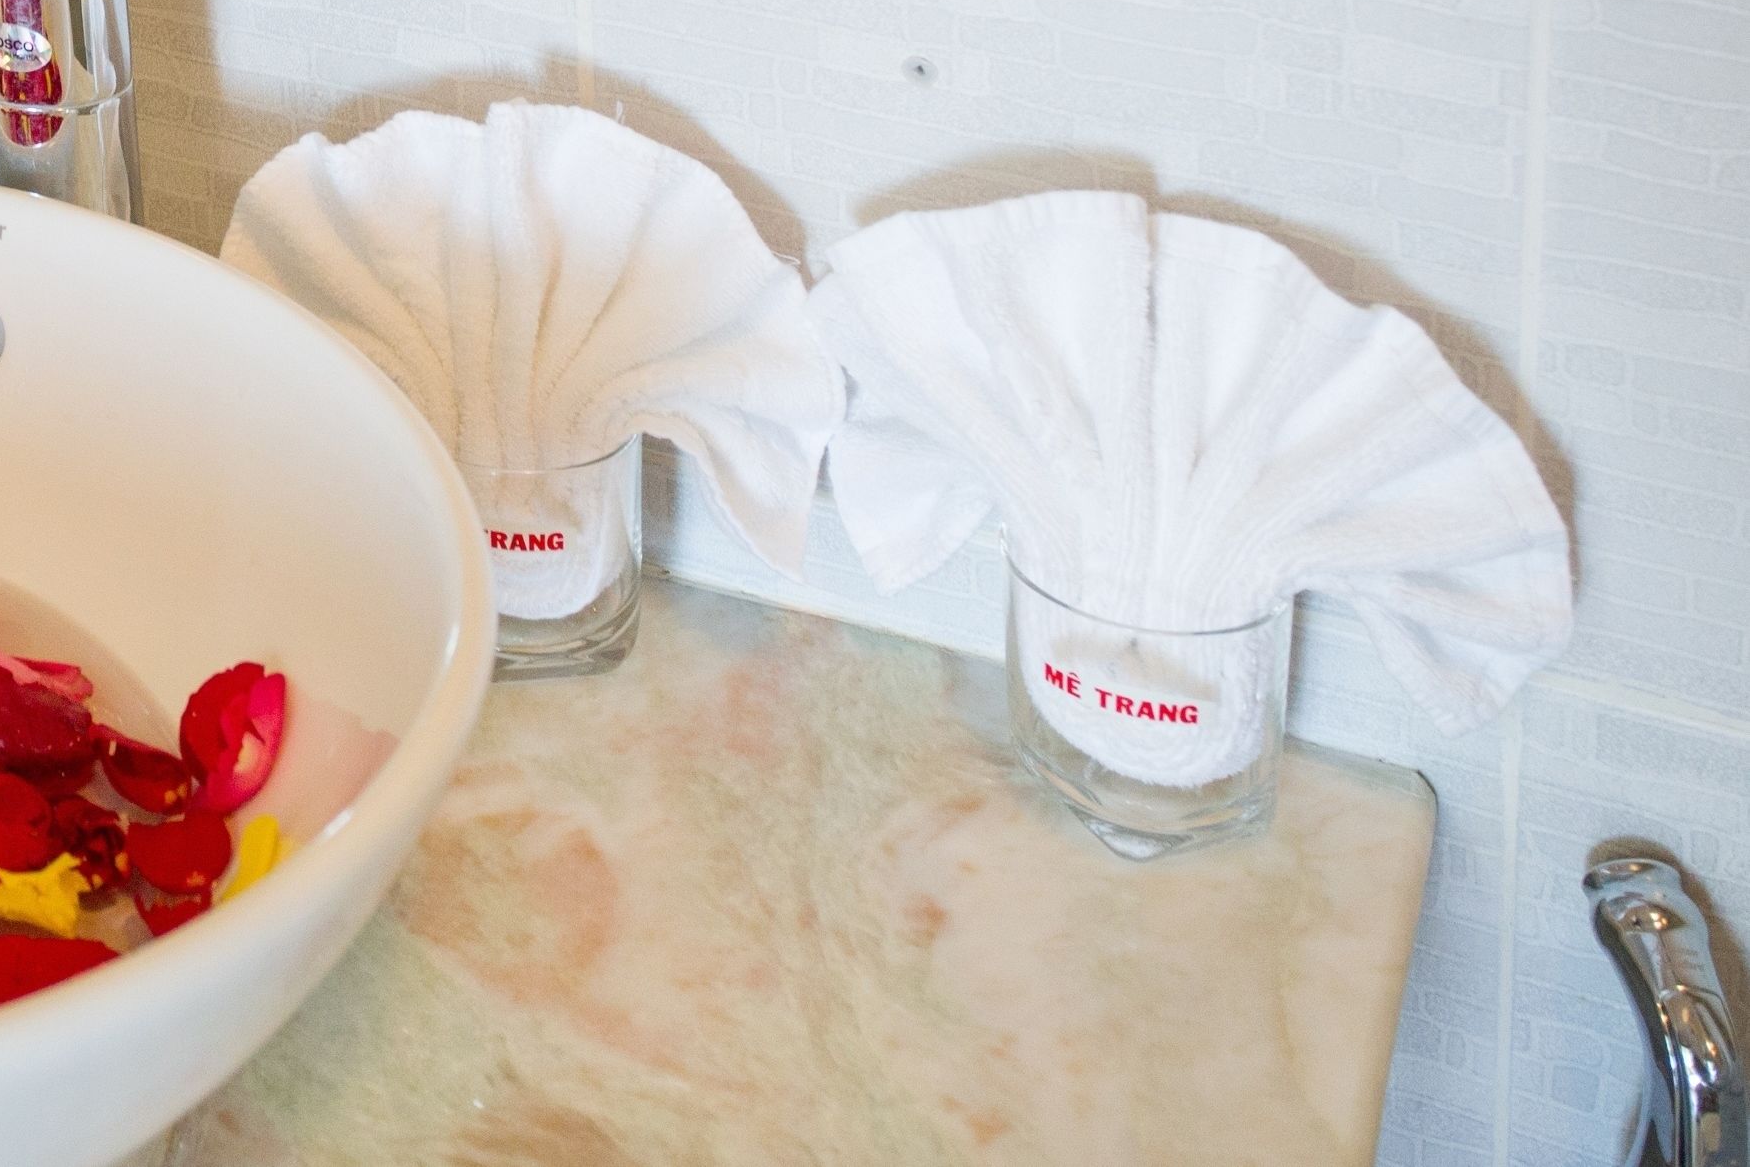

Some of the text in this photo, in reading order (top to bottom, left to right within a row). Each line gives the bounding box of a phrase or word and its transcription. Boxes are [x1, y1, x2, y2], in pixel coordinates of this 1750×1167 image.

[484, 529, 564, 551] RANG
[1045, 663, 1198, 724] MÊ TRANG
